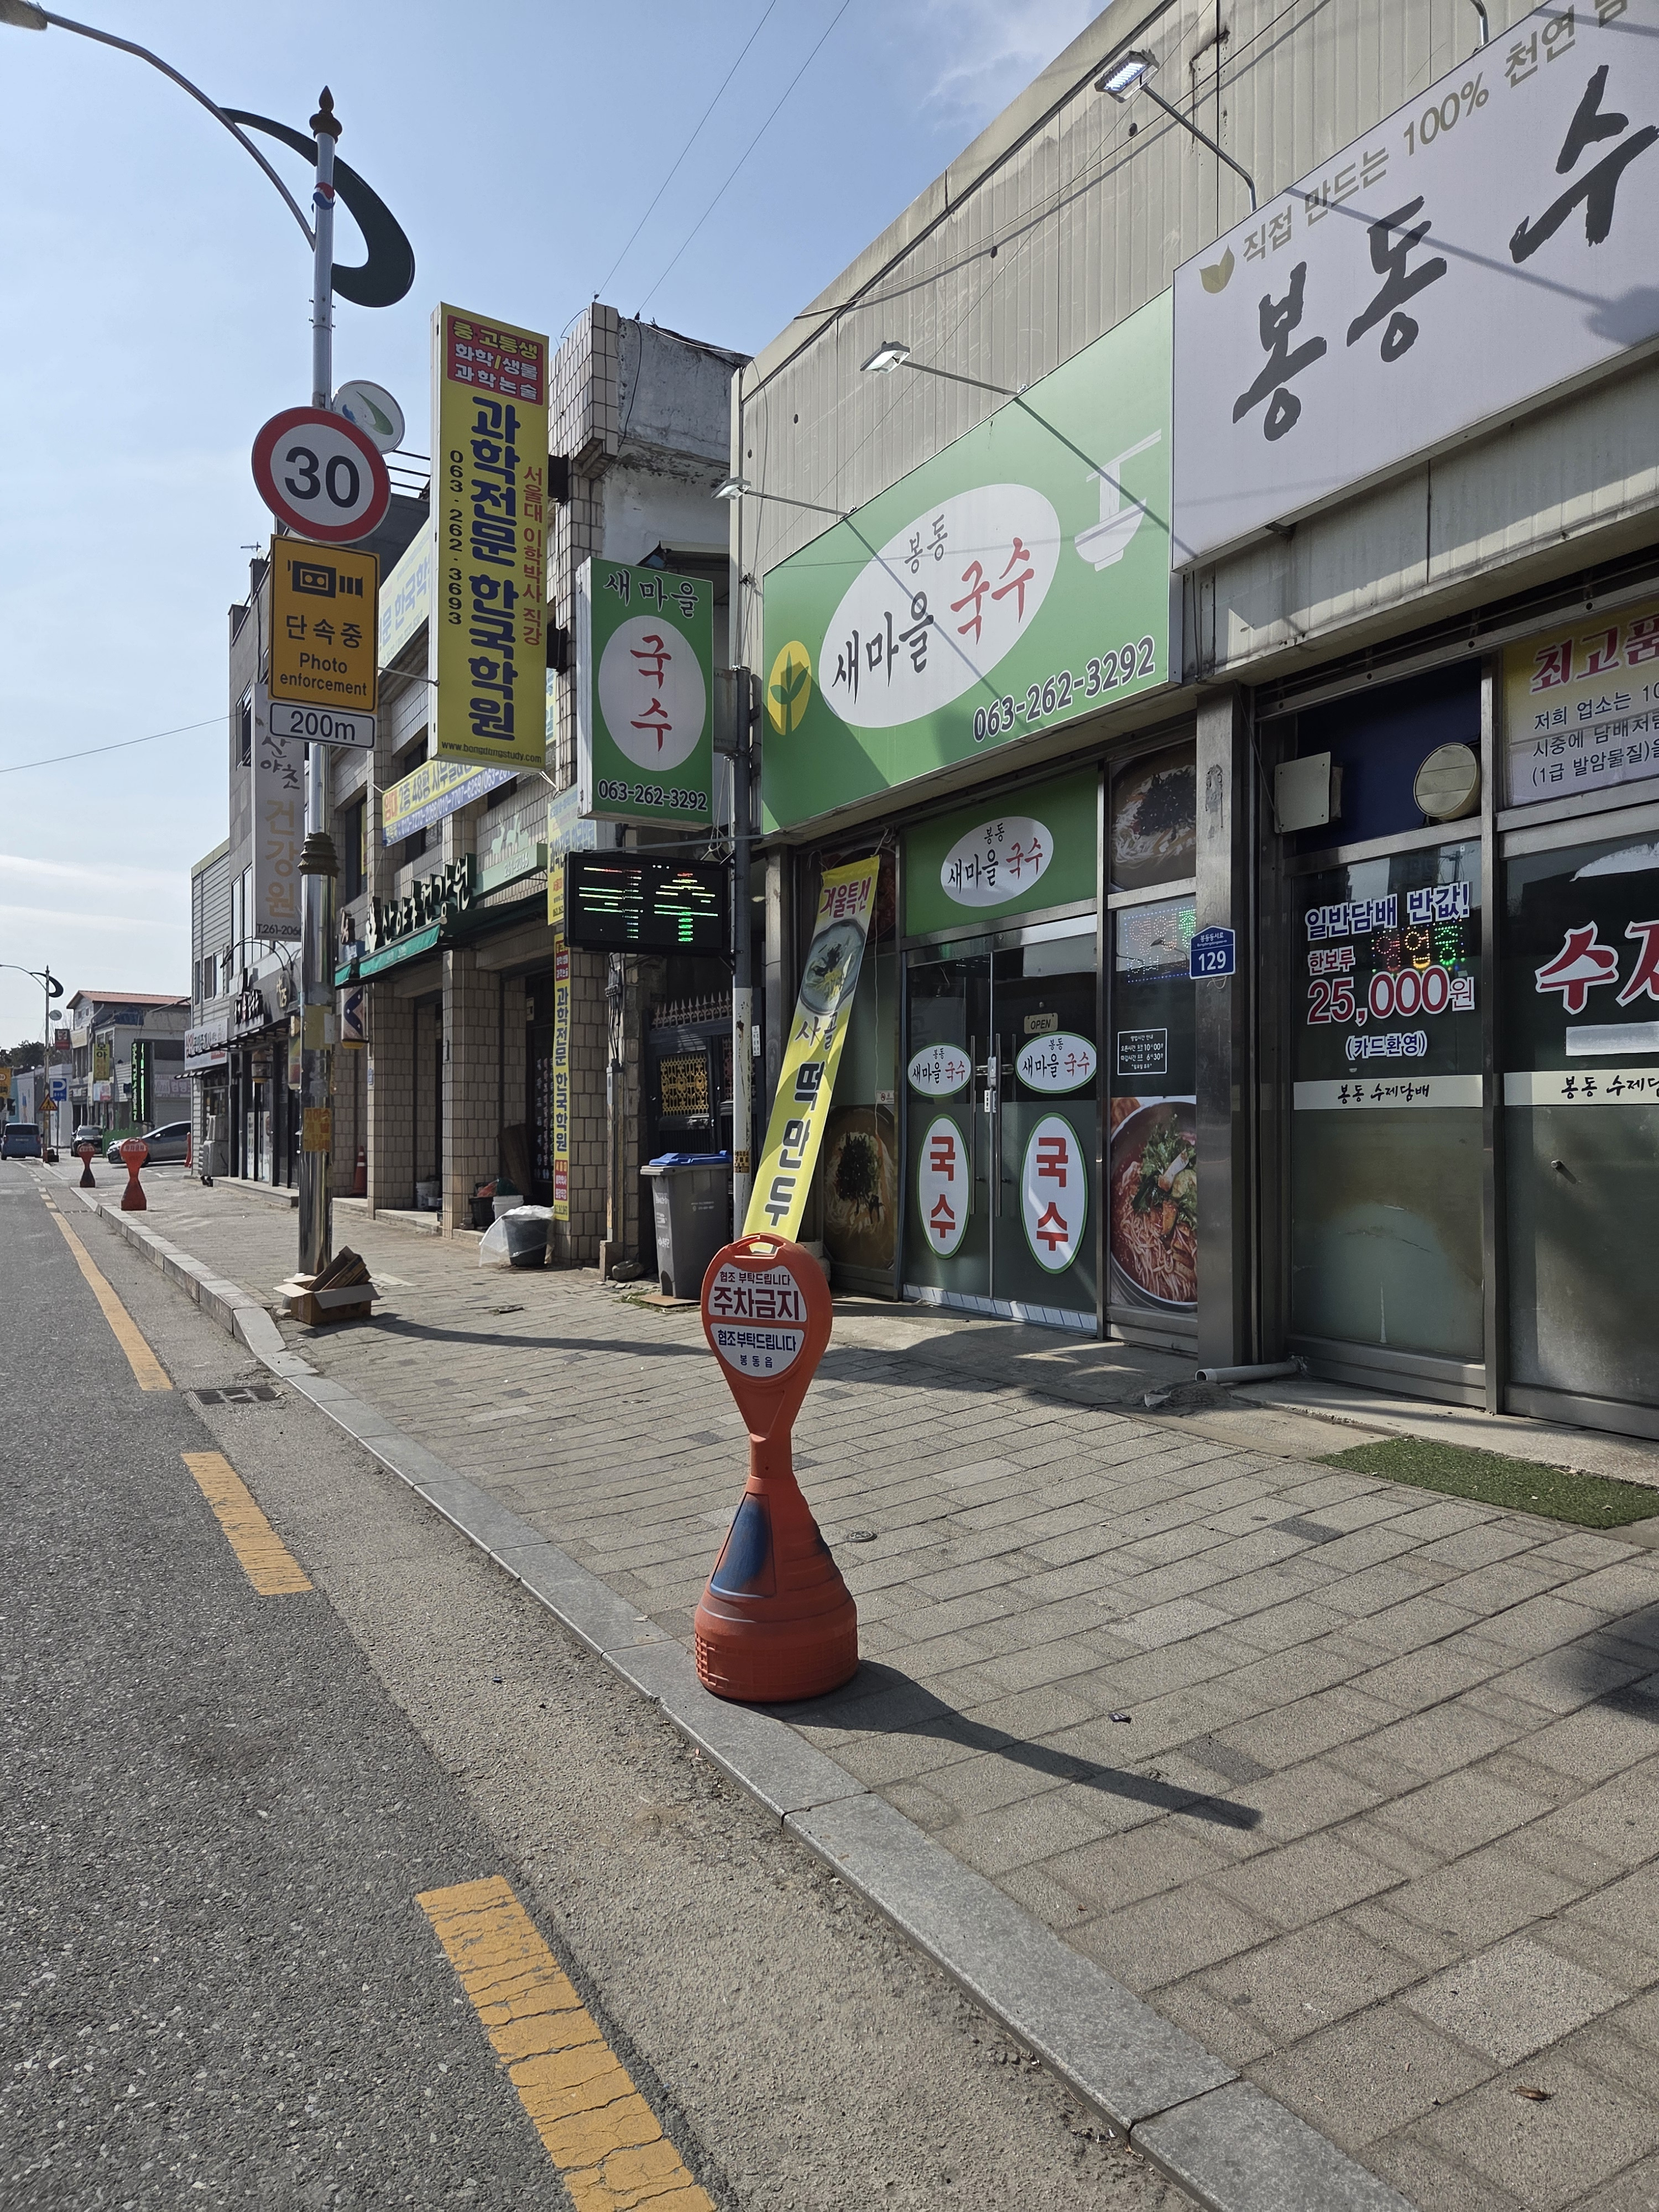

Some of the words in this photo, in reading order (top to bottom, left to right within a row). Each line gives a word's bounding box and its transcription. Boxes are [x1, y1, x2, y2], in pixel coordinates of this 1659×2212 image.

[1243, 205, 1292, 264] 직접
[1305, 146, 1387, 227] 만드는
[1404, 71, 1490, 156] 100%
[1504, 4, 1575, 88] 천연
[1233, 196, 1447, 441] 봉동
[455, 363, 538, 400] 과학논술
[284, 446, 361, 509] 30
[469, 396, 521, 567] 과학전문
[523, 466, 543, 523] 서울대
[904, 514, 948, 573] 봉동
[523, 527, 543, 603] 이학박사
[604, 570, 698, 618] 새마을
[286, 614, 362, 649] 단속중
[523, 607, 542, 646] 직강
[832, 592, 934, 705] 새마을
[950, 537, 1035, 645] 국수
[300, 653, 348, 675] Photo
[468, 573, 519, 742] 한국학원
[280, 671, 367, 697] enforcement
[630, 635, 672, 752] 국수
[973, 636, 1156, 742] 063-262-3292
[290, 711, 356, 742] 200m
[1534, 706, 1567, 730] 저희
[1577, 692, 1631, 721] 업소는
[1533, 729, 1584, 757] 시중에
[1532, 763, 1564, 787] (1급
[598, 780, 708, 811] 063-262-3292
[984, 823, 1005, 844] 봉동
[265, 800, 299, 919] 건강원
[948, 850, 999, 894] 새마을
[1005, 838, 1043, 879] 국수
[1306, 895, 1398, 941] 일반담배
[1408, 881, 1470, 925] 반값!
[1198, 950, 1226, 971] 129
[1309, 947, 1355, 975] 한보루
[1376, 925, 1458, 971] 영업중
[1307, 965, 1475, 1026] 25,000원
[555, 986, 569, 1067] 과학전문
[795, 1014, 837, 1050] 사골
[1030, 1018, 1052, 1030] OPEN
[932, 1048, 945, 1060] 봉동
[1048, 1037, 1064, 1051] 봉동
[1346, 1031, 1427, 1059] (카드환영)
[912, 1061, 941, 1084] 새마을
[945, 1060, 966, 1082] 국수
[1022, 1053, 1060, 1079] 새마을
[1063, 1051, 1090, 1077] 국수
[50, 1079, 66, 1097] P
[1338, 1084, 1364, 1104] 봉동
[1370, 1083, 1430, 1102] 수제담배
[1561, 1076, 1598, 1099] 봉동
[555, 1072, 568, 1152] 한국학원
[765, 1061, 825, 1227] 떡만두
[930, 1136, 956, 1239] 국수
[1036, 1137, 1069, 1251] 국수
[720, 1271, 735, 1282] 협조
[739, 1272, 791, 1286] 부탁드립니다
[714, 1286, 800, 1321] 주차금지
[740, 1354, 773, 1368] 봉동읍
